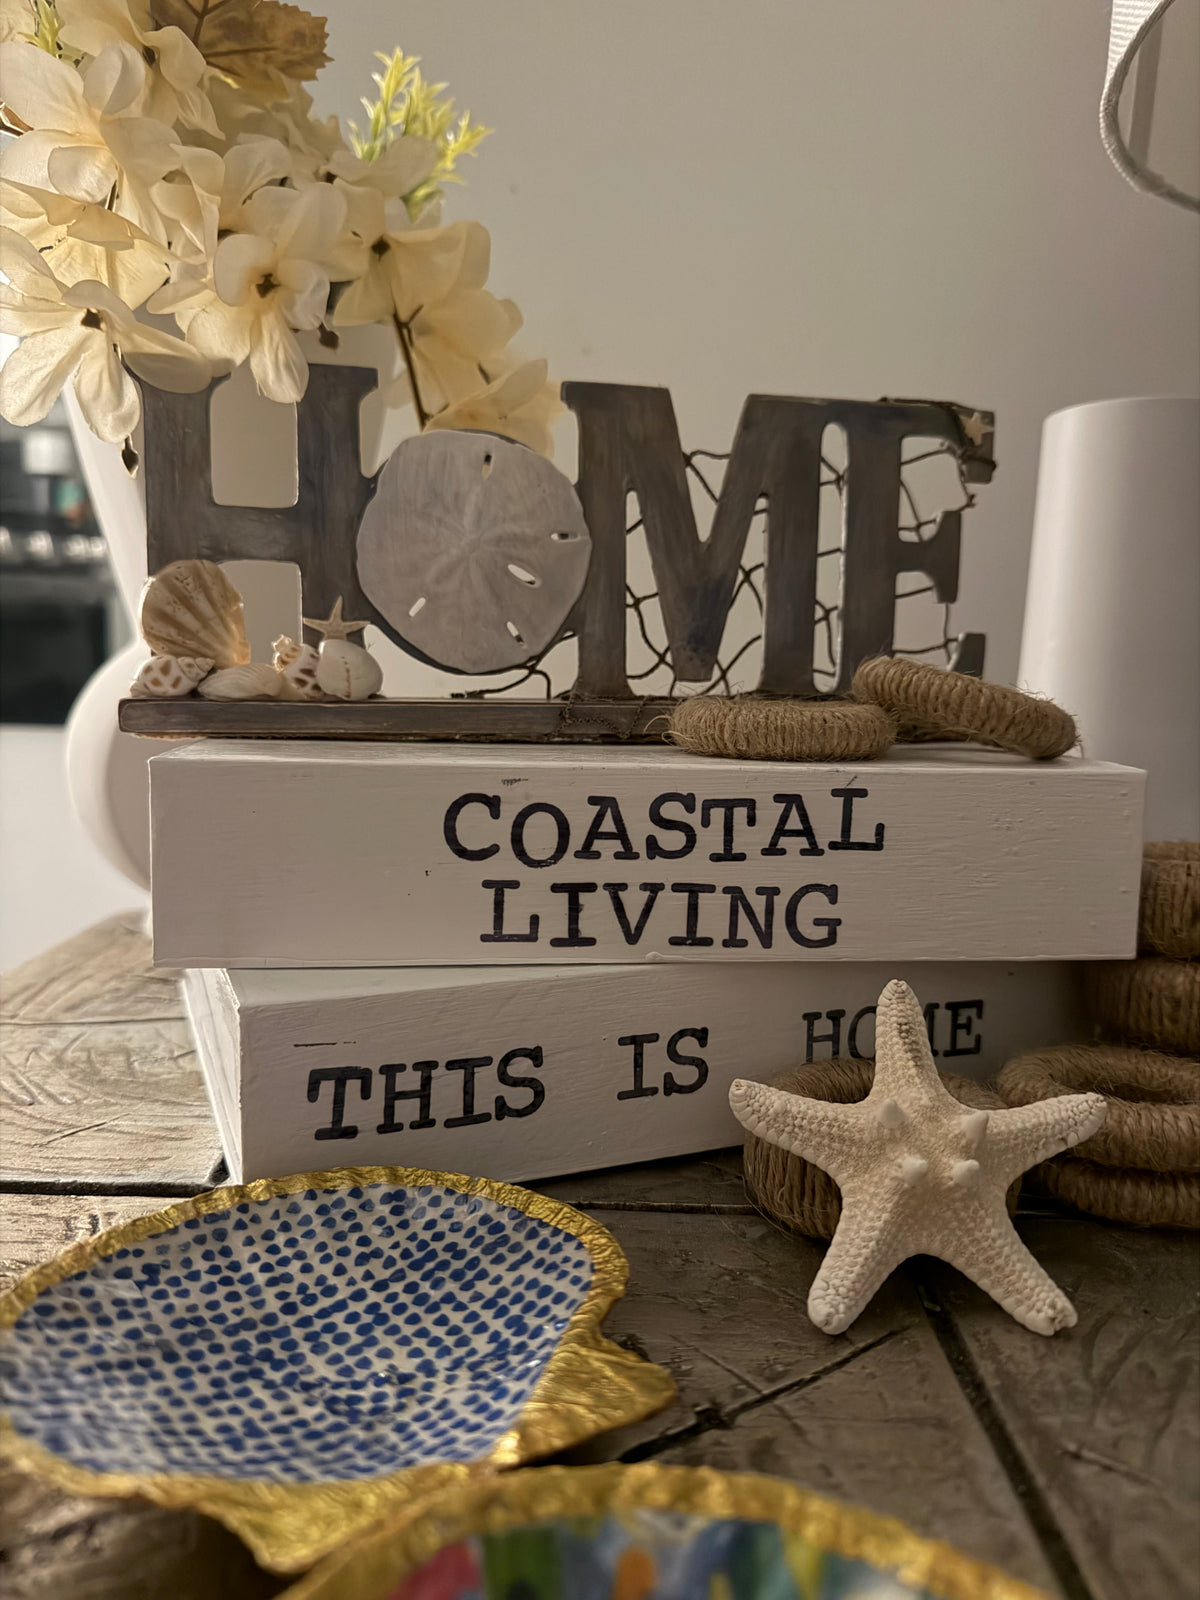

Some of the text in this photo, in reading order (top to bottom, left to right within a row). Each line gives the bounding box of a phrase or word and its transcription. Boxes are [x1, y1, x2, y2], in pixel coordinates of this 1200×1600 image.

[443, 787, 885, 868] COASTAL
[479, 879, 842, 948] LIVING
[306, 1045, 546, 1140] THIS
[616, 1026, 710, 1100] IS
